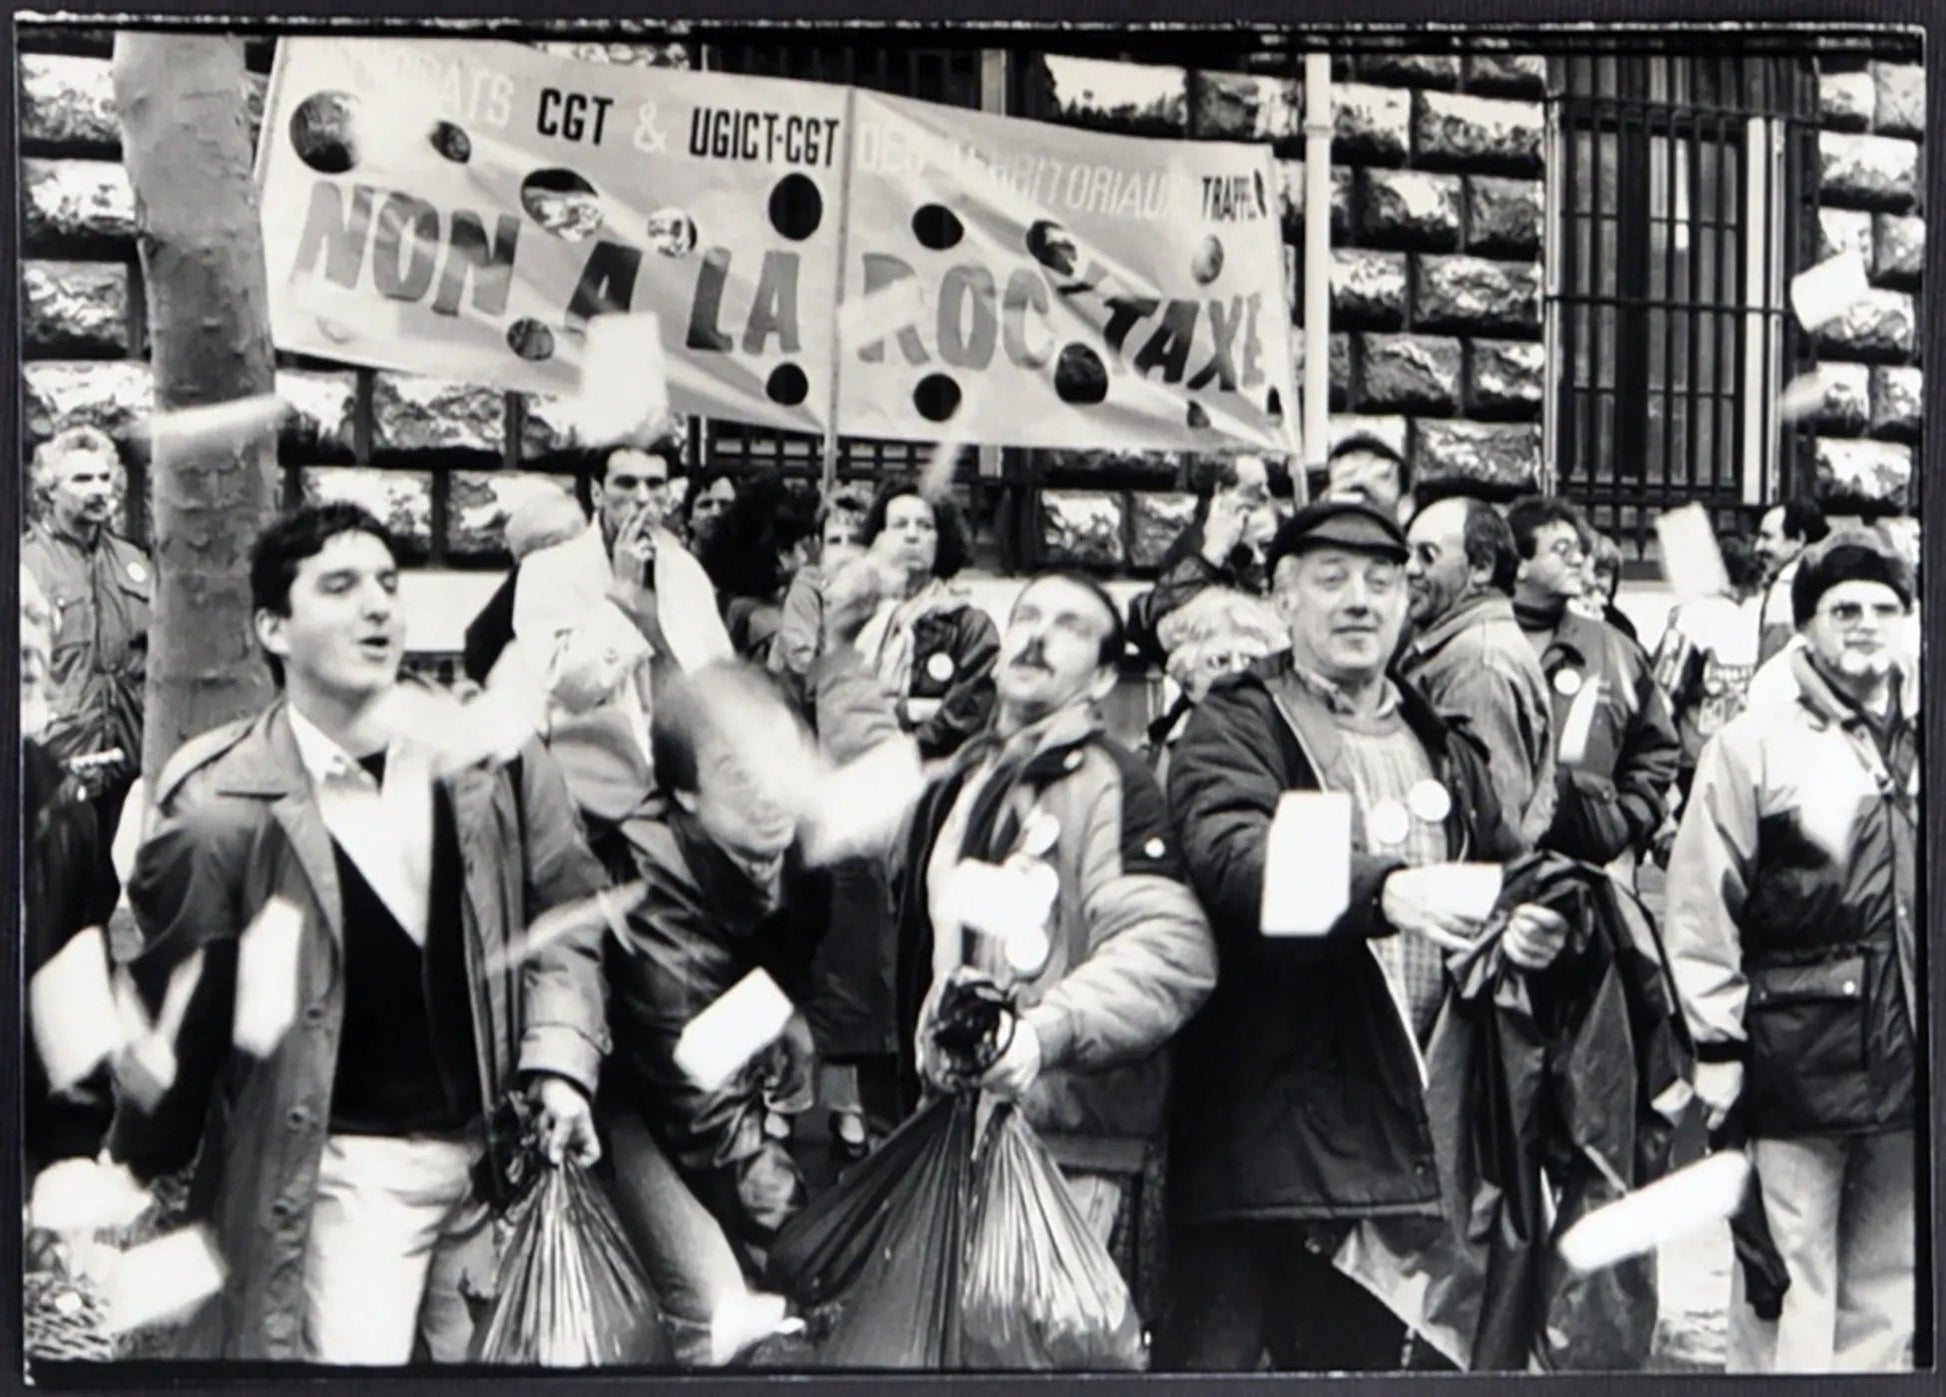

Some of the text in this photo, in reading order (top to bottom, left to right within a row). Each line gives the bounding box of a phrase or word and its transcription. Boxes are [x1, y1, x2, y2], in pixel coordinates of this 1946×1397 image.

[537, 88, 614, 145] CGT
[634, 101, 668, 152] &
[289, 181, 521, 318] NON
[563, 240, 644, 332] A
[686, 246, 800, 355] LA
